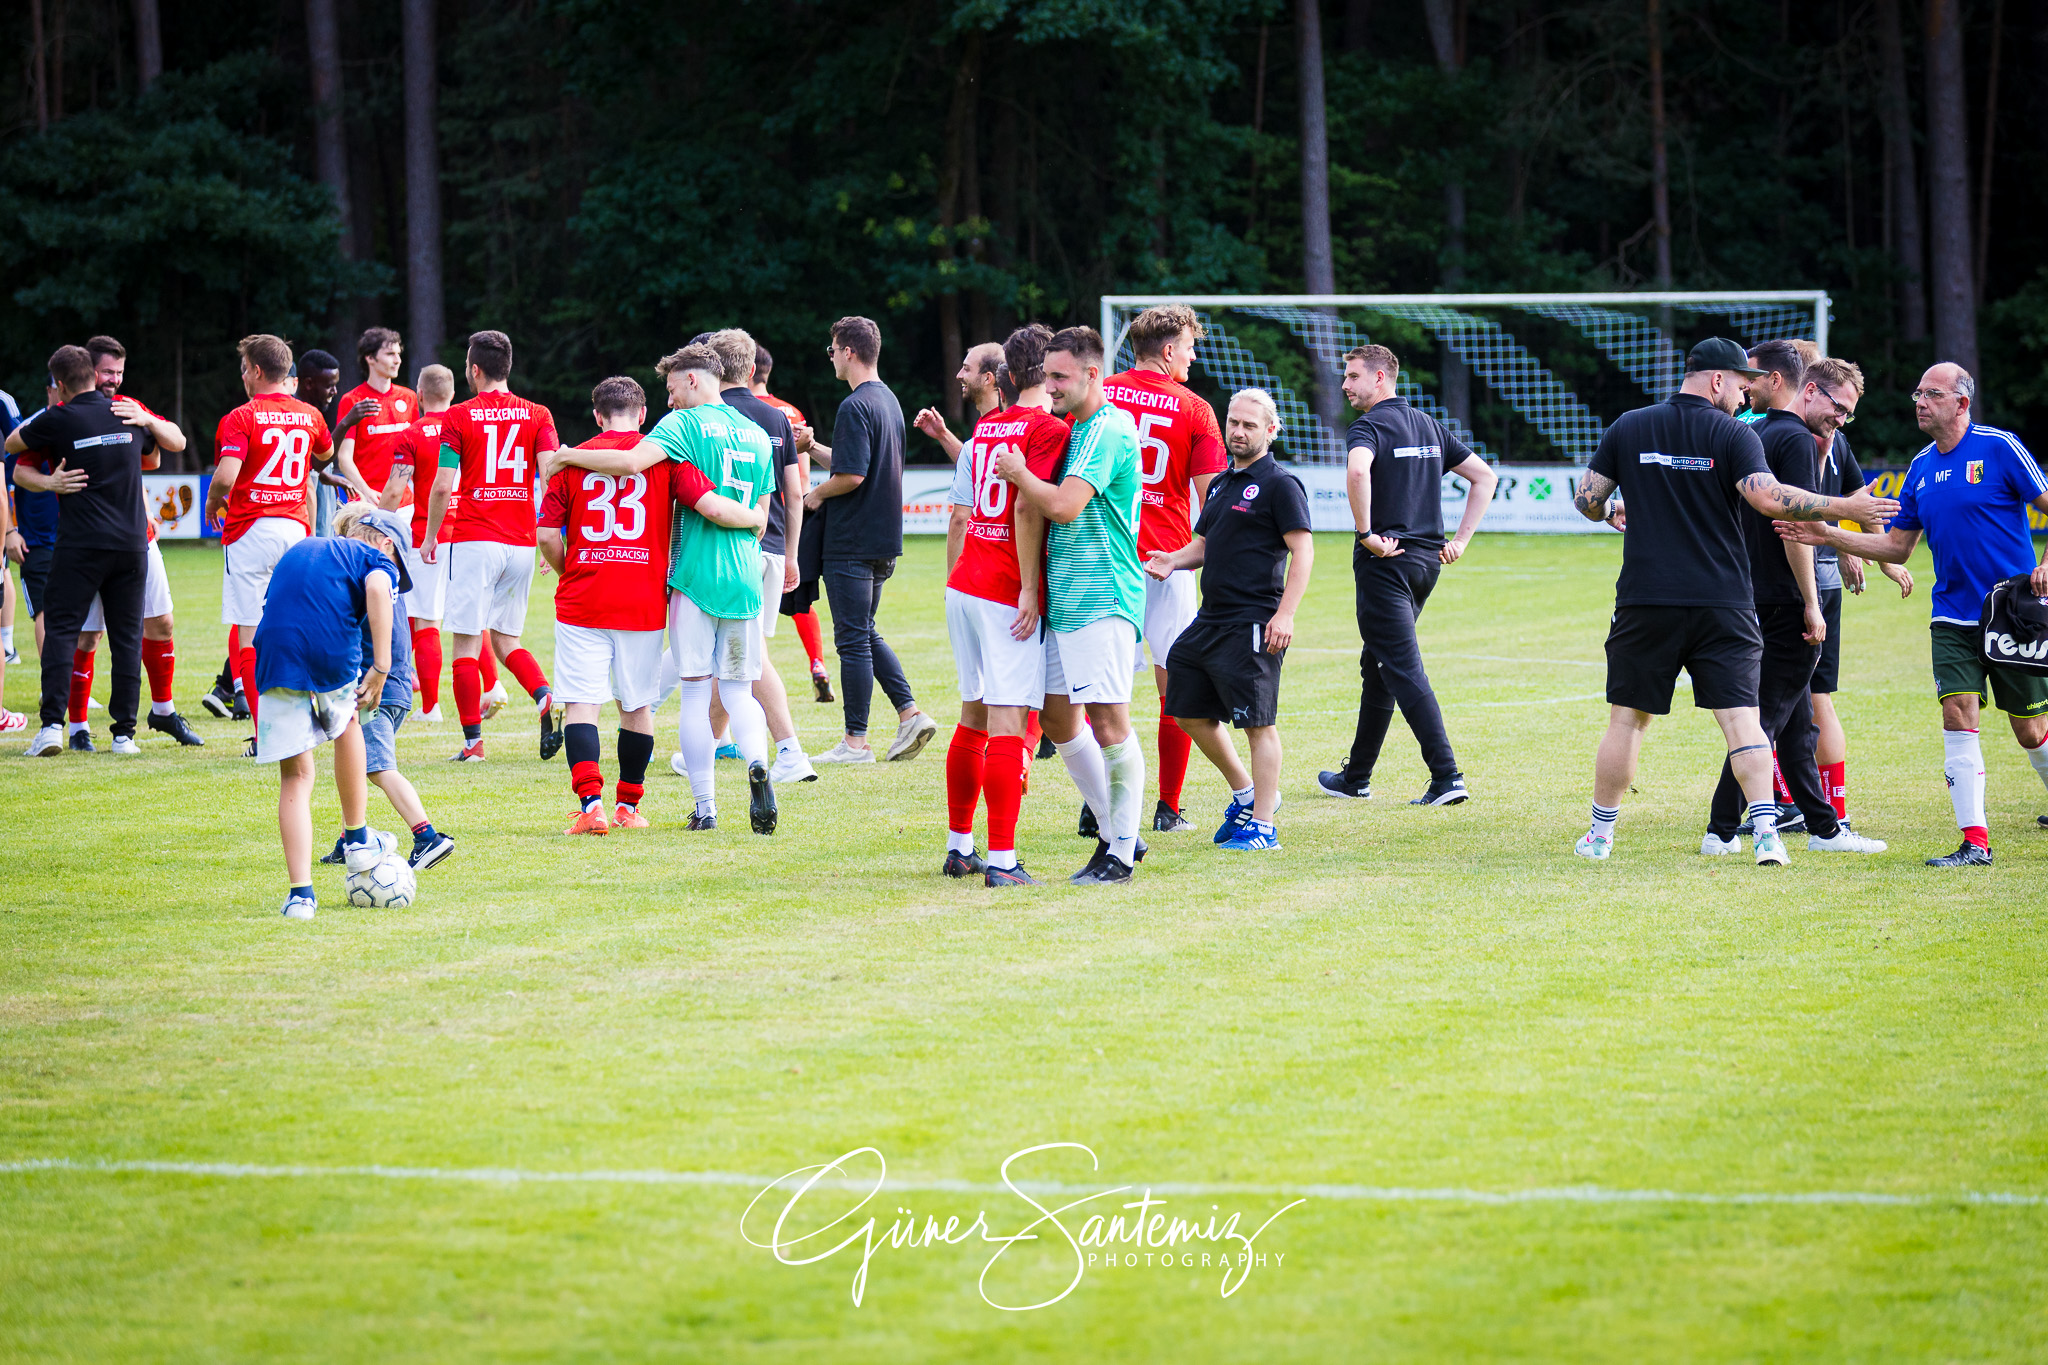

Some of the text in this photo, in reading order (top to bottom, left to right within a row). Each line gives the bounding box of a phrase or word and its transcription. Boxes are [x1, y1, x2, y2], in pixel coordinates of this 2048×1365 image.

[1116, 386, 1180, 412] ECKENTAL
[269, 412, 313, 427] ECKENTAL
[253, 427, 310, 487] 28
[483, 423, 528, 484] 14
[1935, 469, 1953, 483] MF
[261, 493, 272, 501] NO
[484, 491, 496, 499] NO
[581, 471, 647, 542] 33
[591, 552, 606, 560] NO
[616, 551, 649, 561] RACISM
